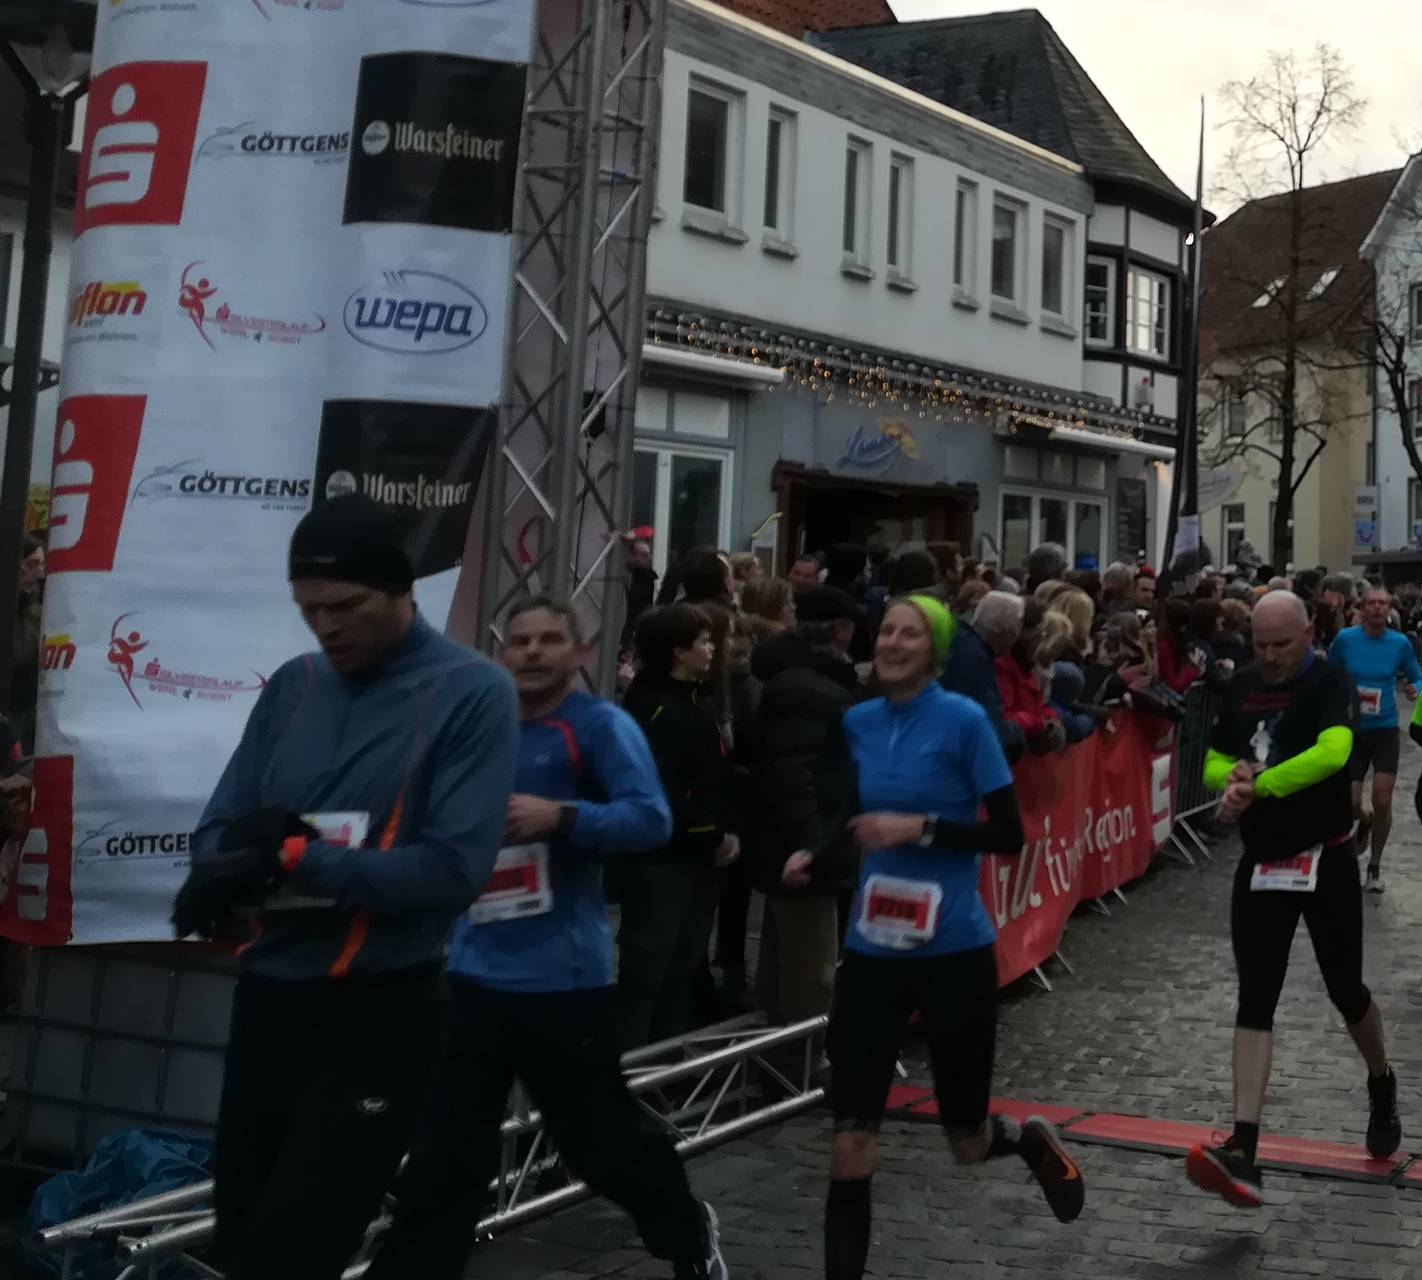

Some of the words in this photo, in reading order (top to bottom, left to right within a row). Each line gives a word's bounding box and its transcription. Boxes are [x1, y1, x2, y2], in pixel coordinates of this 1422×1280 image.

[240, 130, 349, 154] GÖTTGENS
[394, 121, 505, 163] Warsteiner
[354, 295, 472, 343] wepa
[179, 469, 310, 498] GÖTTGENS
[362, 472, 472, 512] Warsteiner
